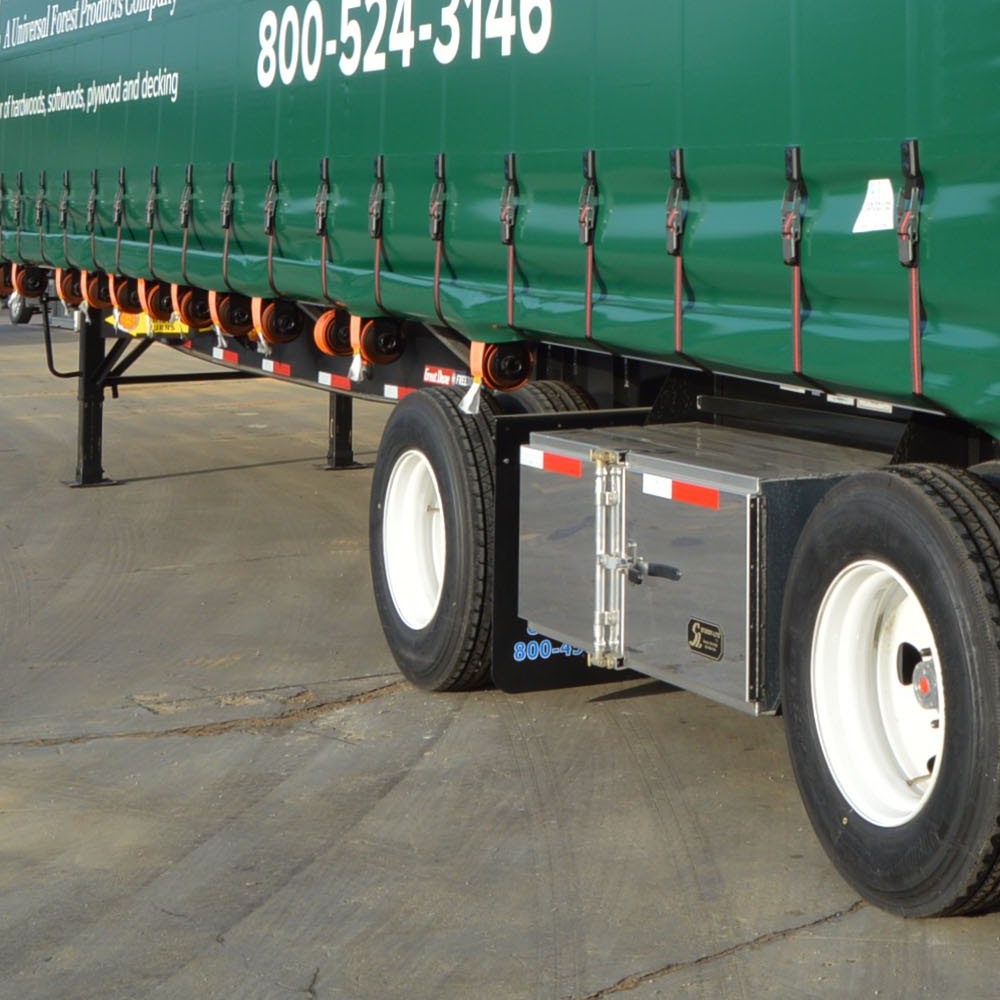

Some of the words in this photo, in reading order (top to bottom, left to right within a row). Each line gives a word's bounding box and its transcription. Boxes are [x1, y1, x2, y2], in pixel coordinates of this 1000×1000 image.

[3, 19, 11, 49] A
[11, 5, 51, 47] Universal
[50, 0, 80, 36] Forest
[3, 95, 12, 119] of
[11, 90, 47, 117] hardwoods,
[47, 83, 86, 113] softwoods,
[86, 75, 122, 114] plywood
[122, 71, 141, 101] and
[141, 66, 179, 103] decking
